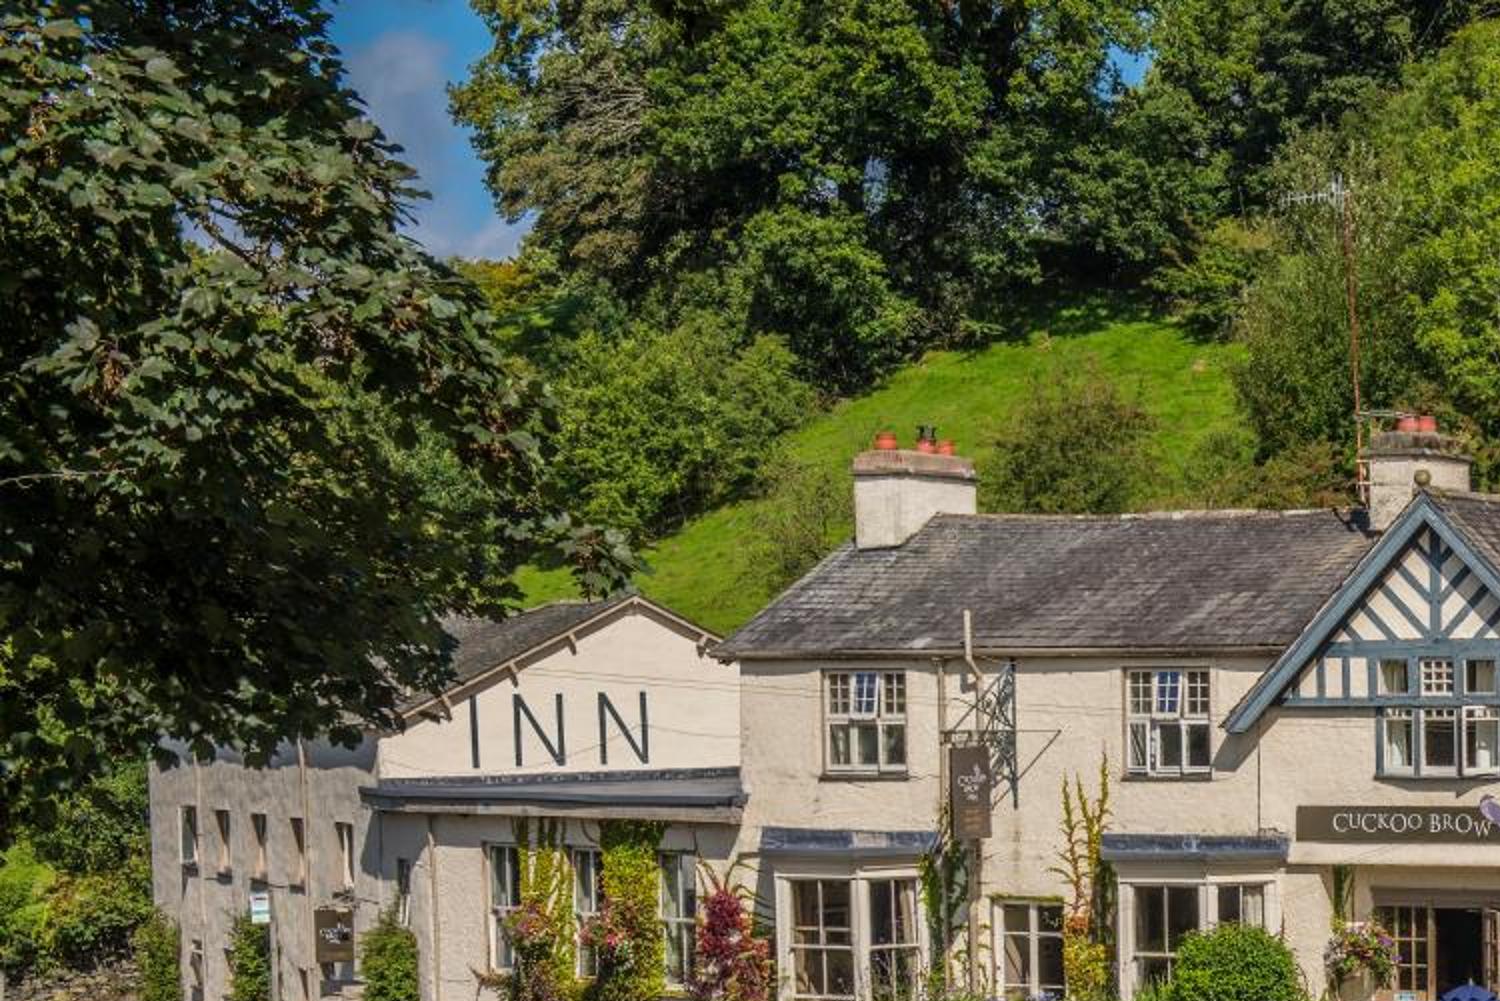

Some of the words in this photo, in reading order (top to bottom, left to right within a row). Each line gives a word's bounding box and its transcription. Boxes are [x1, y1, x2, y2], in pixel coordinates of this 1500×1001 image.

[469, 691, 649, 769] INN
[1332, 813, 1423, 833] CUCKOO
[1429, 813, 1492, 838] BROW
